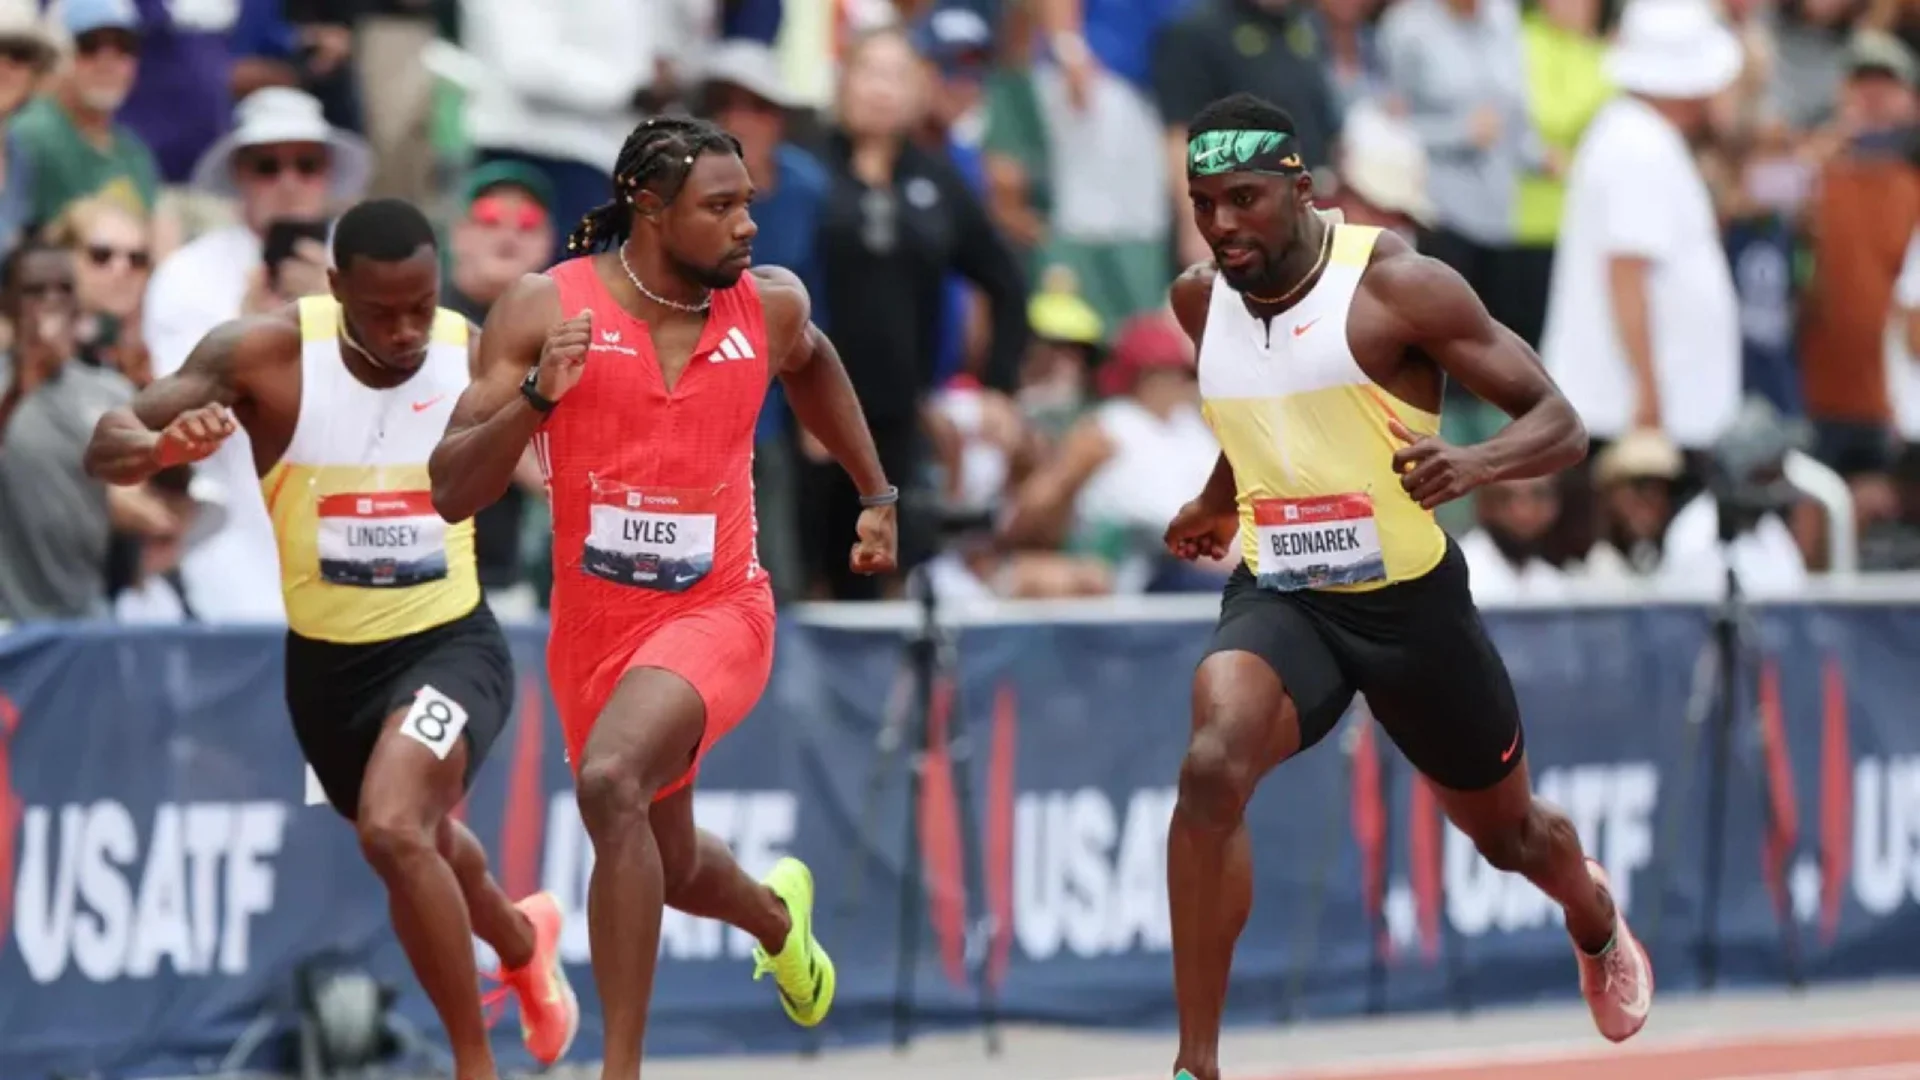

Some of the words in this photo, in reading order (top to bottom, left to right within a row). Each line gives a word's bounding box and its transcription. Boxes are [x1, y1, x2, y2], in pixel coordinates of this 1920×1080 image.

[347, 525, 419, 547] LINDSEY
[622, 518, 677, 545] LYLES
[1271, 526, 1360, 557] BEDNAREK
[414, 700, 452, 742] 8
[13, 797, 288, 985] USATF
